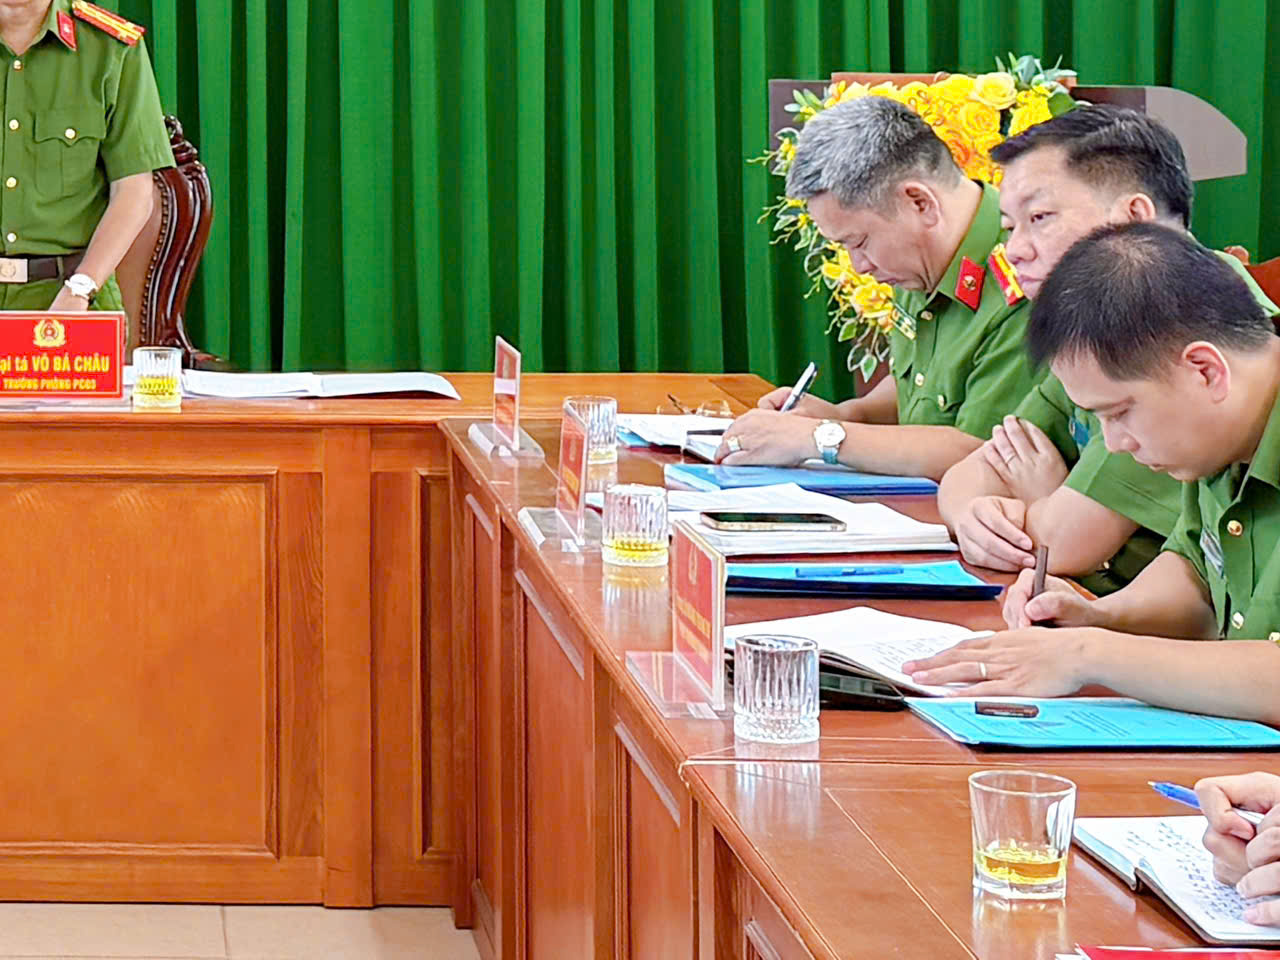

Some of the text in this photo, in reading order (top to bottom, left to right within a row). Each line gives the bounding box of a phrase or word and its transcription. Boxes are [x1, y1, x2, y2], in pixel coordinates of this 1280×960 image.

[14, 355, 28, 371] tá
[53, 352, 70, 371] BÁ
[73, 352, 109, 371] CHÂU
